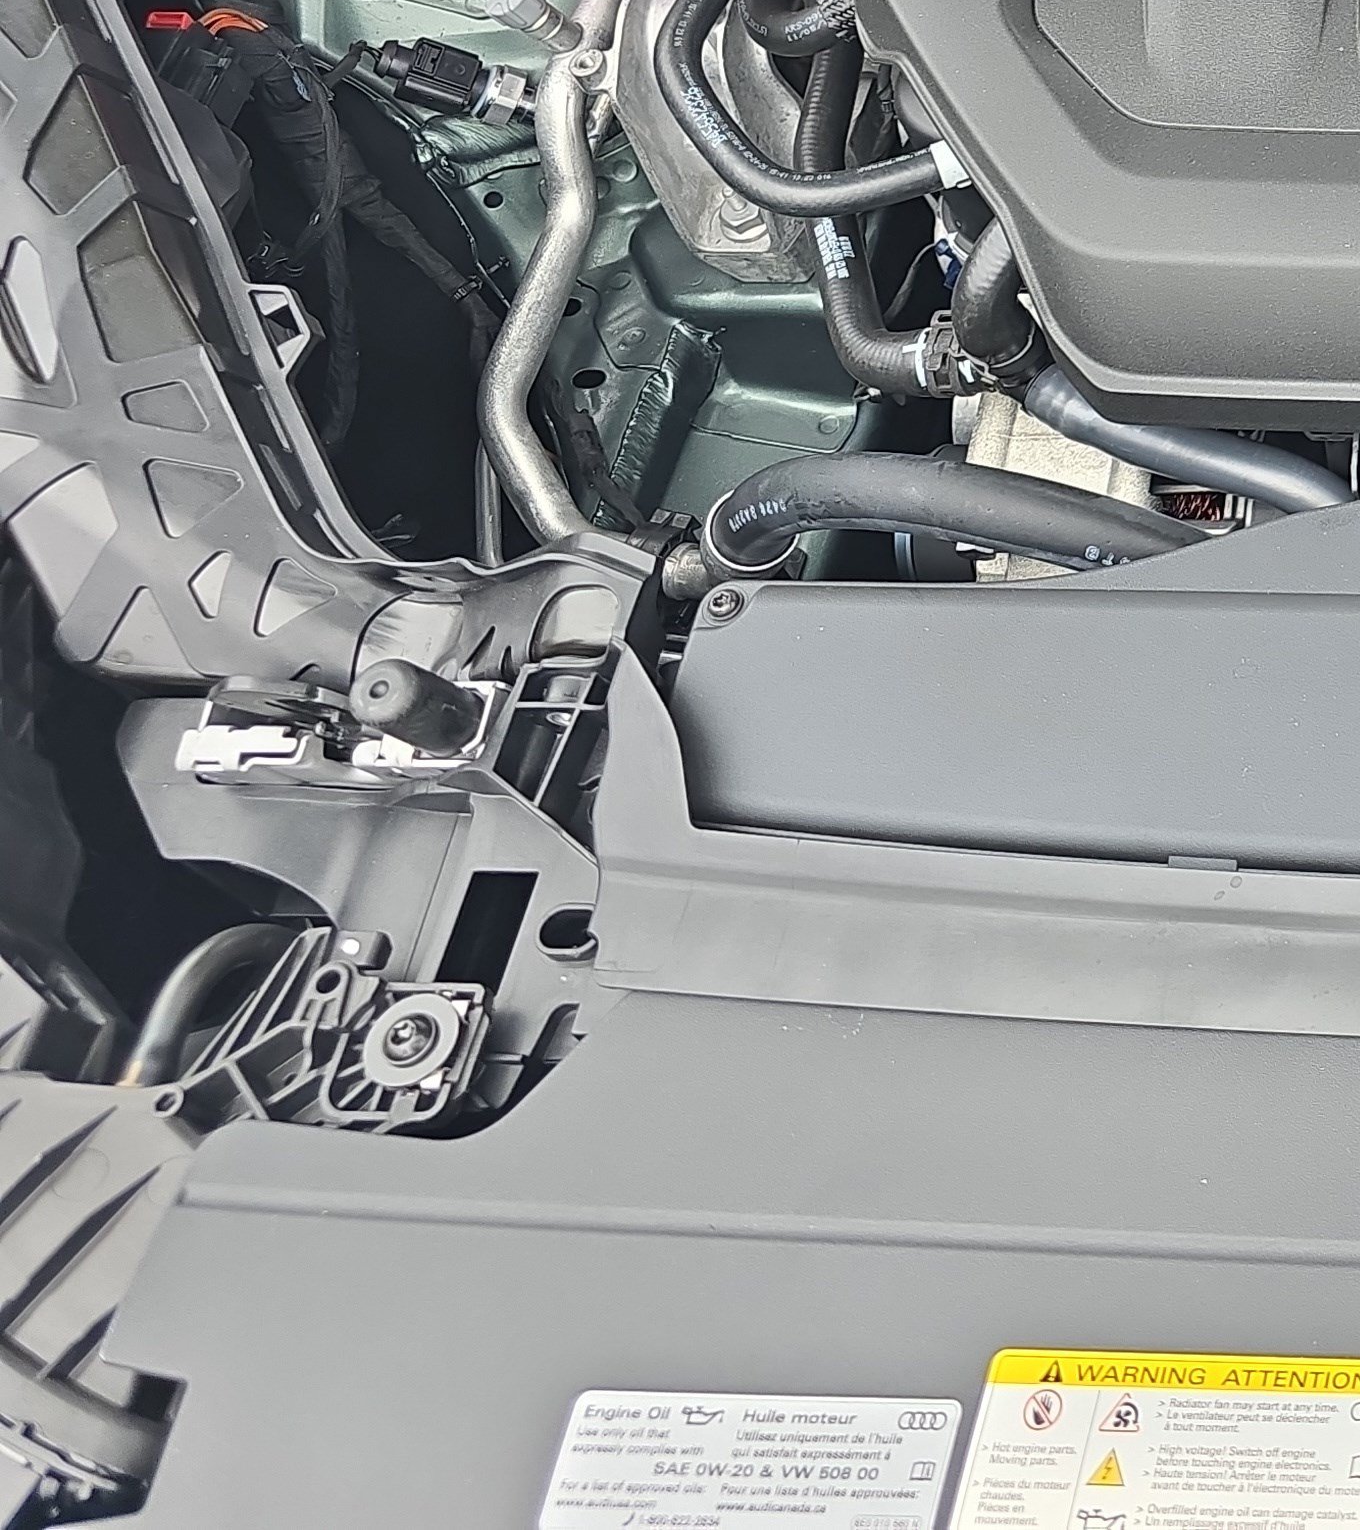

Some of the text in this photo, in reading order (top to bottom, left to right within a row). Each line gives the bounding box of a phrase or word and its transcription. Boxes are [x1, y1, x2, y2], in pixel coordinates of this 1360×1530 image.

[1076, 1363, 1207, 1386] WARNING
[584, 1404, 672, 1423] Engine Oil
[1169, 1398, 1212, 1409] Radiator
[1214, 1398, 1230, 1410] fan
[1232, 1402, 1253, 1413] may
[1256, 1401, 1280, 1411] start
[1281, 1402, 1291, 1412] at
[1293, 1404, 1312, 1414] any
[743, 1408, 857, 1425] Huile moteur
[1166, 1410, 1180, 1420] Le
[1181, 1410, 1235, 1421] ventilateur
[1236, 1413, 1260, 1423] peut
[603, 1426, 626, 1439] only
[1173, 1422, 1194, 1431] tout
[735, 1430, 778, 1442] Utilisez
[779, 1433, 848, 1446] uniquement
[851, 1433, 865, 1444] de
[731, 1447, 750, 1459] qui
[992, 1441, 1011, 1453] Hot
[1012, 1443, 1048, 1455] engine
[1158, 1444, 1184, 1456] High
[1229, 1446, 1264, 1458] Switch
[1265, 1446, 1280, 1458] off
[1281, 1448, 1316, 1461] engine
[988, 1453, 1028, 1467] Moving
[1156, 1456, 1189, 1467] before
[1191, 1458, 1236, 1470] touching
[1238, 1459, 1273, 1471] engine
[653, 1461, 880, 1481] SAE 0W-20 & VW 508 00
[1153, 1468, 1183, 1478] Haute
[1267, 1471, 1277, 1481] le
[1279, 1473, 1318, 1483] moteur
[720, 1483, 746, 1496] Pour
[750, 1486, 771, 1496] une
[1017, 1479, 1031, 1490] du
[1033, 1481, 1072, 1490] moteur
[1150, 1481, 1180, 1491] avant
[1181, 1481, 1195, 1491] de
[1196, 1482, 1236, 1493] toucher
[1318, 1485, 1332, 1496] du
[1012, 1504, 1026, 1514] en
[1147, 1503, 1198, 1516] Overfilled
[1199, 1505, 1235, 1518] engine
[1236, 1506, 1250, 1517] oil
[1252, 1508, 1271, 1518] can
[1272, 1508, 1316, 1521] damage
[1145, 1516, 1161, 1527] Un
